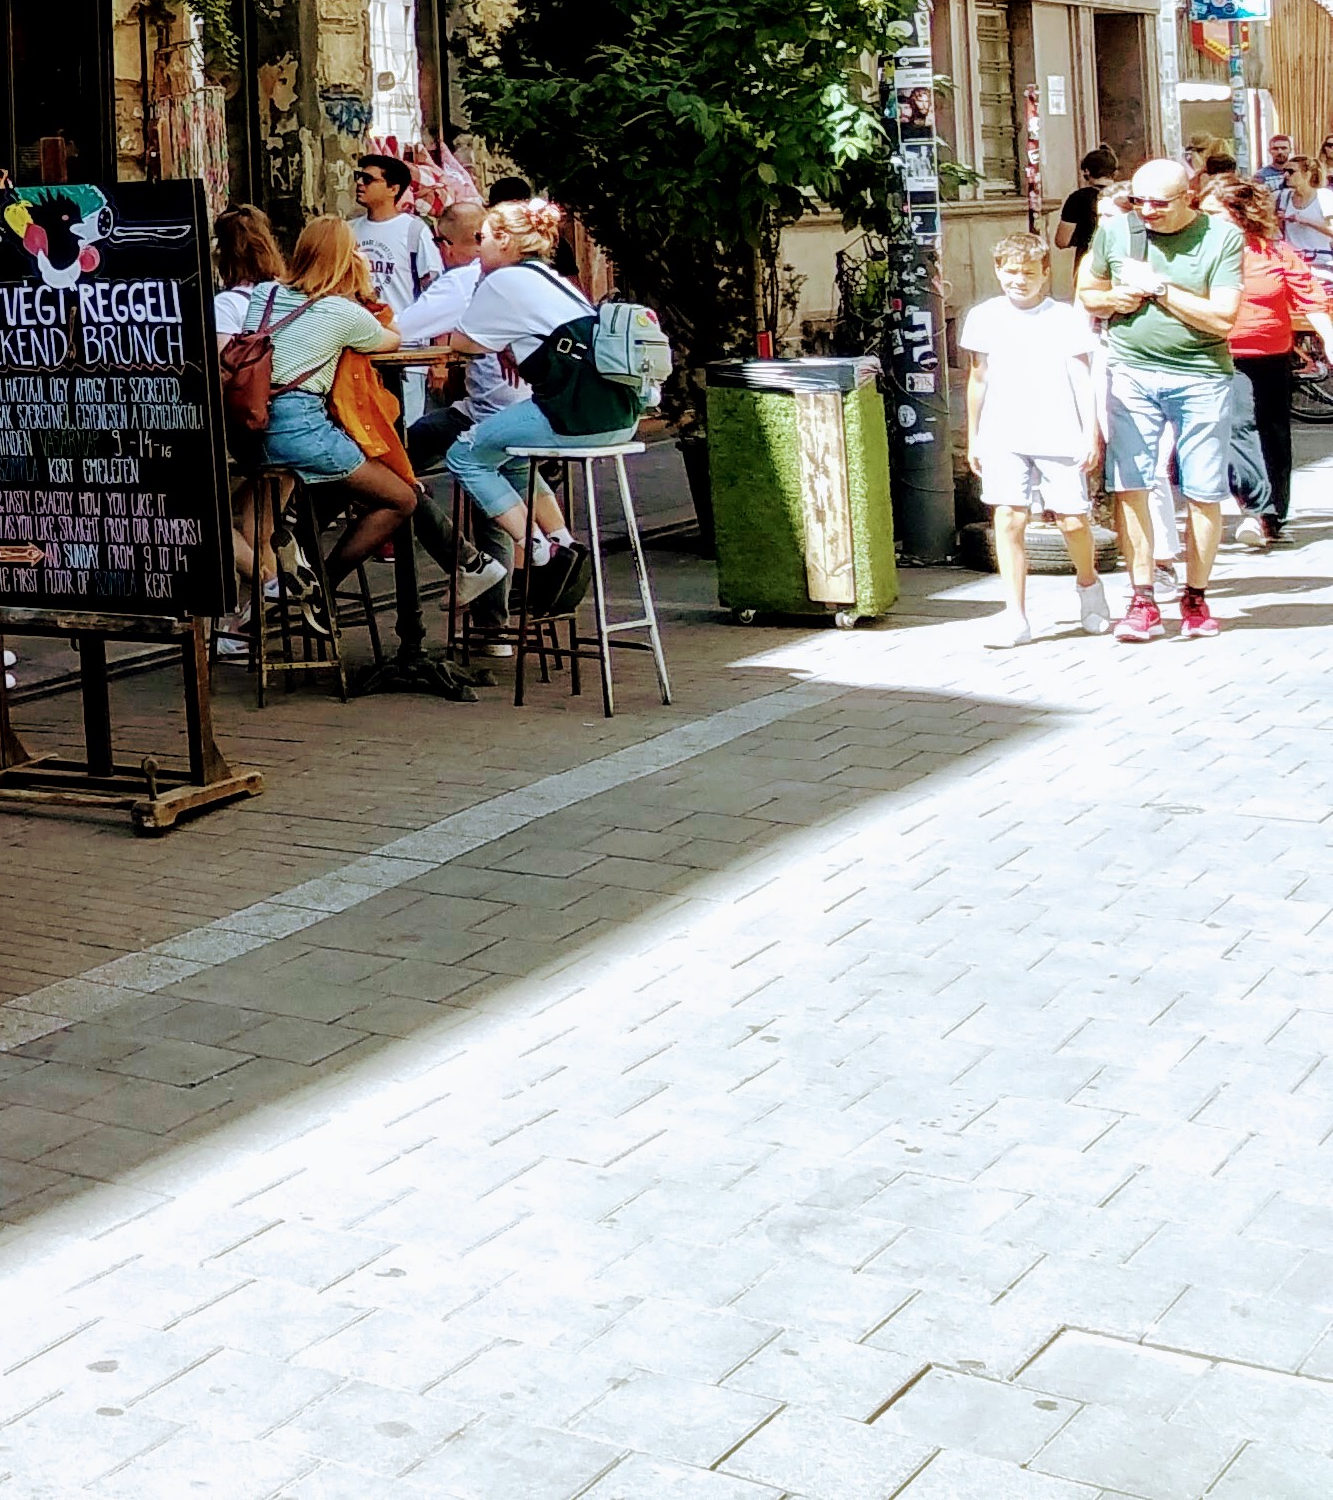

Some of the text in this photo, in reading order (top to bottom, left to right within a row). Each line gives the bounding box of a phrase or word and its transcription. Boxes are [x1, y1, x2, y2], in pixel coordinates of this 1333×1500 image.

[80, 281, 183, 324] REGGELI
[83, 325, 184, 366] BRUNCH
[75, 377, 106, 403] AHOGY
[110, 378, 126, 403] TE
[132, 404, 140, 429] A
[111, 430, 123, 456] 9
[48, 458, 74, 483] KERT
[35, 491, 73, 515] EXACTLY
[78, 492, 101, 516] HOW
[105, 492, 126, 516] YOU
[131, 493, 154, 517] LIKE
[158, 493, 167, 517] IT
[104, 518, 129, 543] FROM
[133, 518, 151, 544] OUR
[44, 542, 62, 569] AND
[64, 545, 100, 570] SUNDAY
[108, 546, 135, 571] FROM
[143, 546, 152, 571] 9
[157, 547, 171, 571] TO
[174, 547, 189, 573] 14
[13, 568, 38, 593] FIRST
[45, 570, 76, 595] FLOOR
[77, 572, 90, 595] OF
[144, 572, 173, 599] KERT
